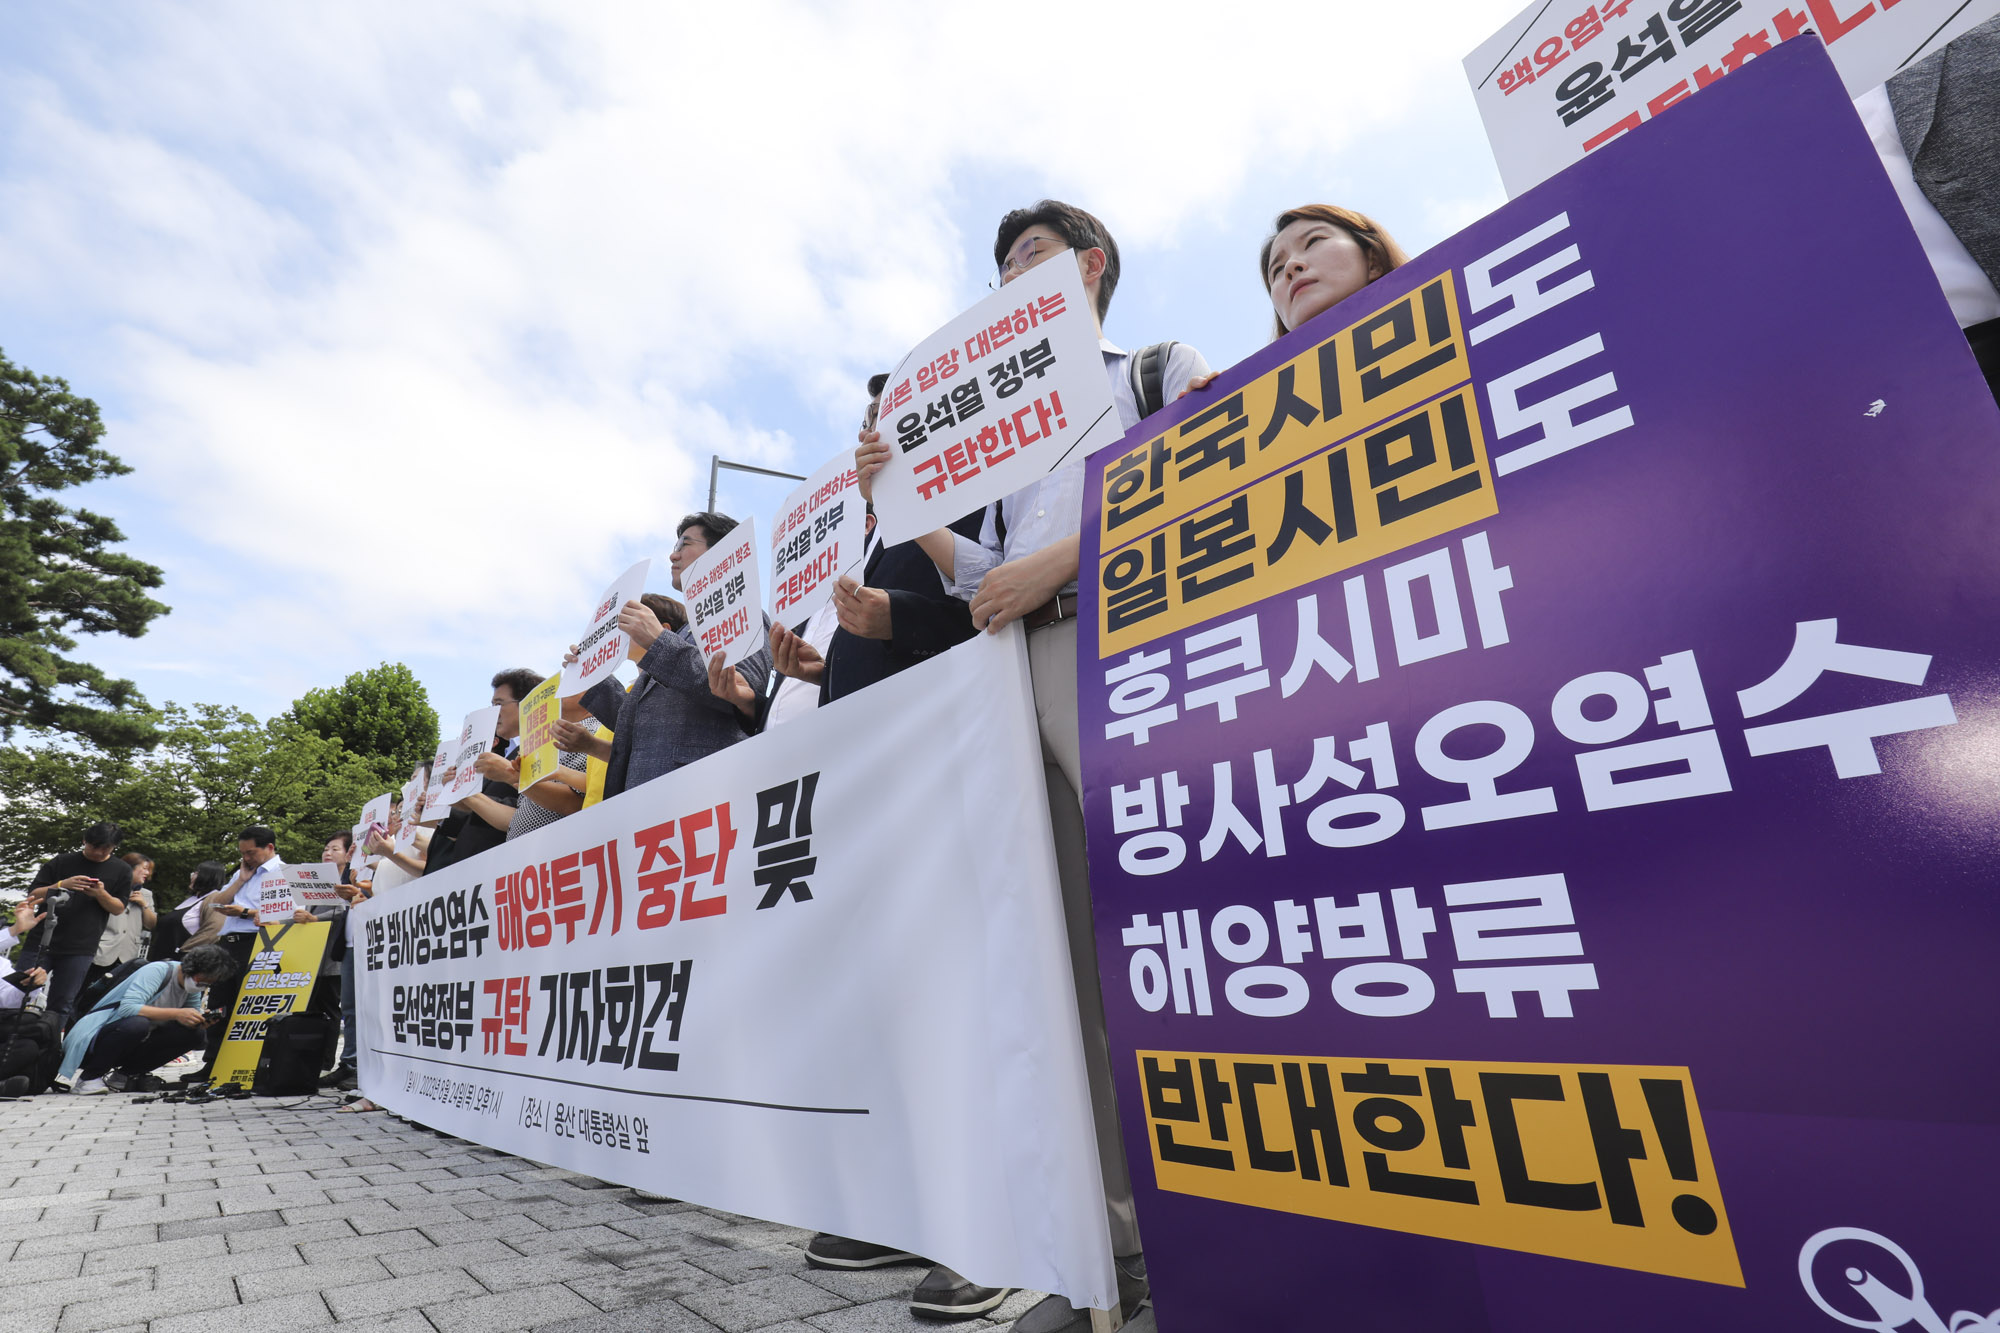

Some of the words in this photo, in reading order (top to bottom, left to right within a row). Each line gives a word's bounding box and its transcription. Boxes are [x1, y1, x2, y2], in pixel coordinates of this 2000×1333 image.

[916, 348, 960, 393] 입장
[964, 292, 1067, 364] 대변하는
[1105, 211, 1596, 532] 한국시민도
[896, 376, 985, 454] 윤석열
[987, 337, 1056, 400] 정부
[912, 390, 1068, 502] 규탄한다!
[1101, 332, 1636, 635] 일본시민도
[776, 525, 811, 577] 윤석열
[814, 500, 845, 544] 정부
[787, 500, 807, 532] 입장
[809, 469, 859, 514] 대변하는
[694, 587, 725, 626] 윤석열
[724, 571, 746, 605] 정부
[709, 553, 736, 584] 해양투기
[735, 541, 751, 564] 방조
[775, 541, 839, 615] 규탄한다!
[594, 591, 619, 624] 일본을
[700, 606, 749, 658] 규탄한다!
[1104, 531, 1514, 745] 후쿠시마
[580, 635, 621, 679] 제소하라!
[1110, 617, 1959, 876] 방사성오염수
[297, 871, 319, 879] 일본은
[366, 916, 385, 972] 일본
[387, 883, 490, 969] 방사성오염수
[494, 838, 624, 953] 해양투기
[634, 801, 738, 931] 중단
[753, 771, 820, 911] 및
[250, 951, 284, 971] 일본
[1121, 872, 1600, 1018] 해양방류
[236, 994, 297, 1016] 해양투기
[392, 980, 475, 1053] 윤석열정부
[481, 975, 531, 1057] 규탄
[537, 959, 693, 1072] 기자회견
[554, 1102, 575, 1139] 용산
[578, 1108, 631, 1151] 대통령실
[632, 1116, 651, 1154] 앞
[1141, 1056, 1720, 1237] 반대한다!
